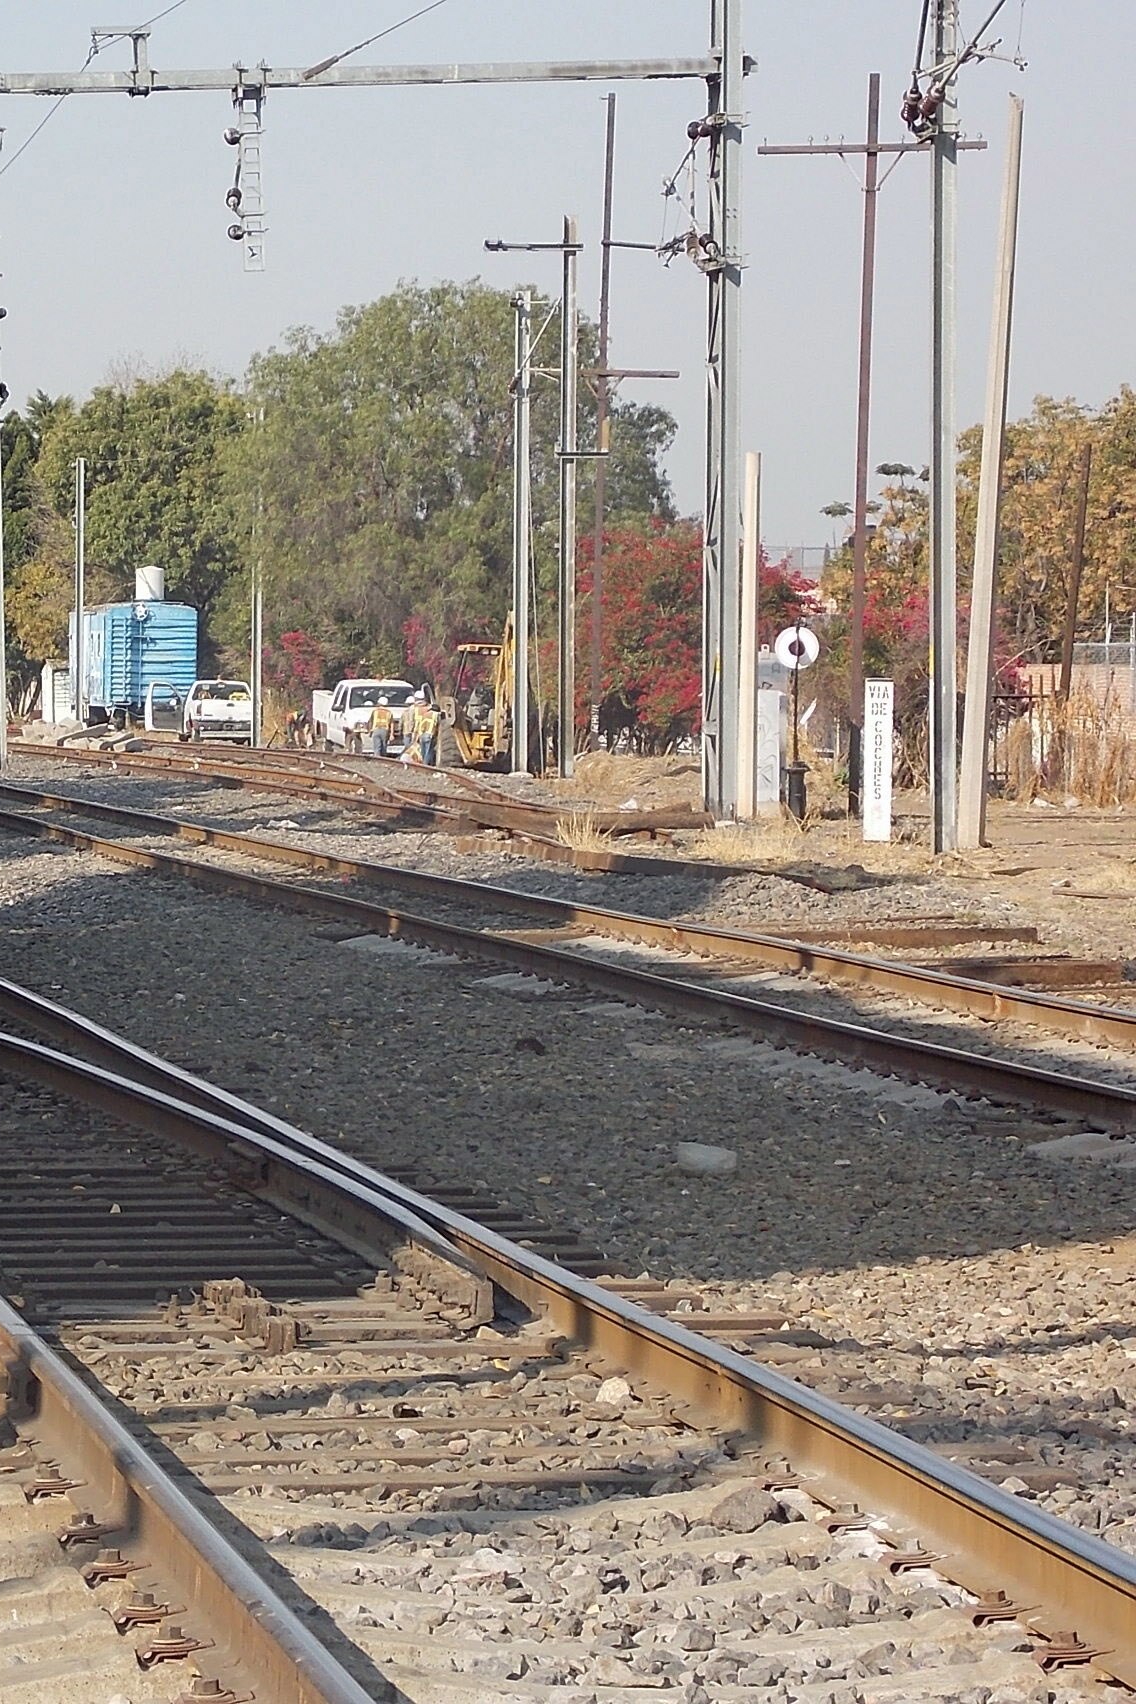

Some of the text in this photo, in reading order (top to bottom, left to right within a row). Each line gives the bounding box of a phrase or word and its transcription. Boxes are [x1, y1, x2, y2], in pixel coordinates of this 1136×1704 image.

[869, 686, 889, 699] VIA
[871, 702, 887, 716] DE
[874, 720, 883, 800] COCHES
